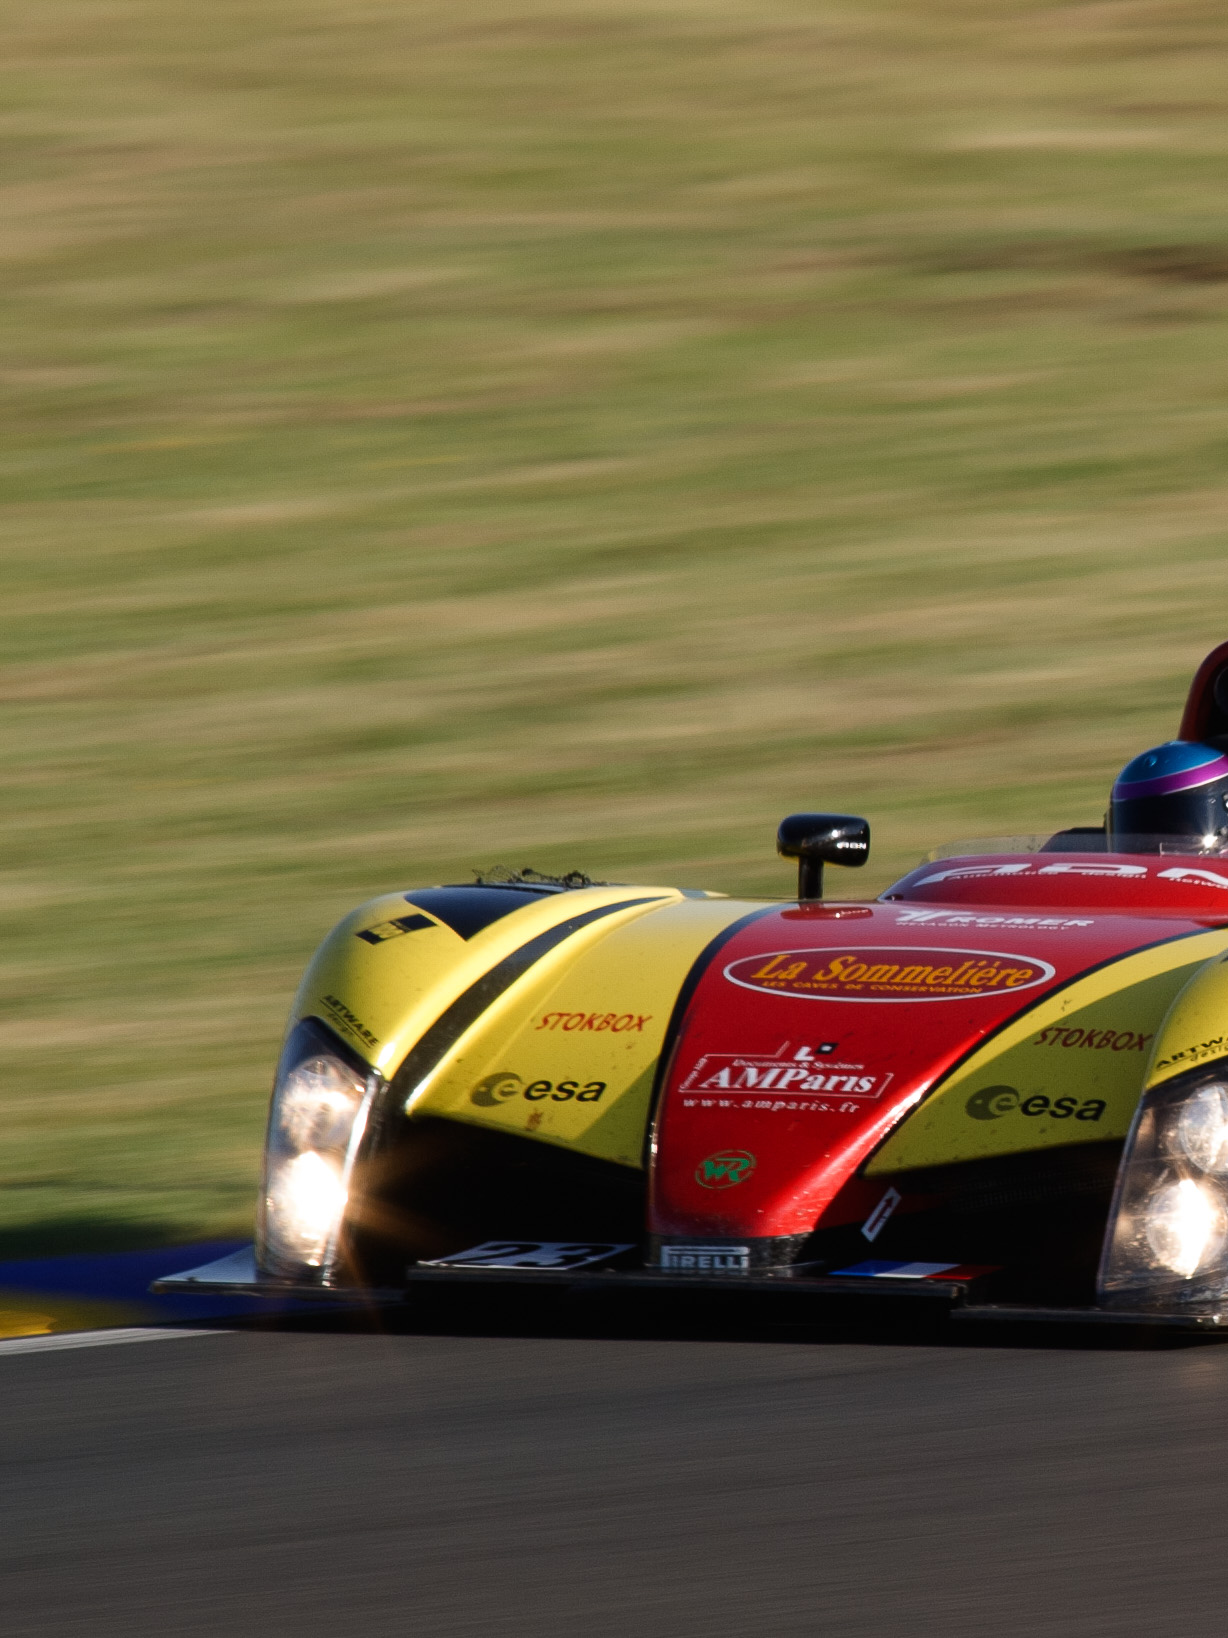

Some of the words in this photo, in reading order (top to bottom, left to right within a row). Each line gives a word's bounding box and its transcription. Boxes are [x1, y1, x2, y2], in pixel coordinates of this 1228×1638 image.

[751, 954, 807, 979] La
[535, 1012, 653, 1033] STOKBOX
[1034, 1027, 1154, 1051] STOKBOX
[523, 1080, 607, 1102] esa
[698, 1067, 877, 1093] AMParis
[1020, 1095, 1108, 1121] esa
[661, 1246, 750, 1269] PIRELLI
